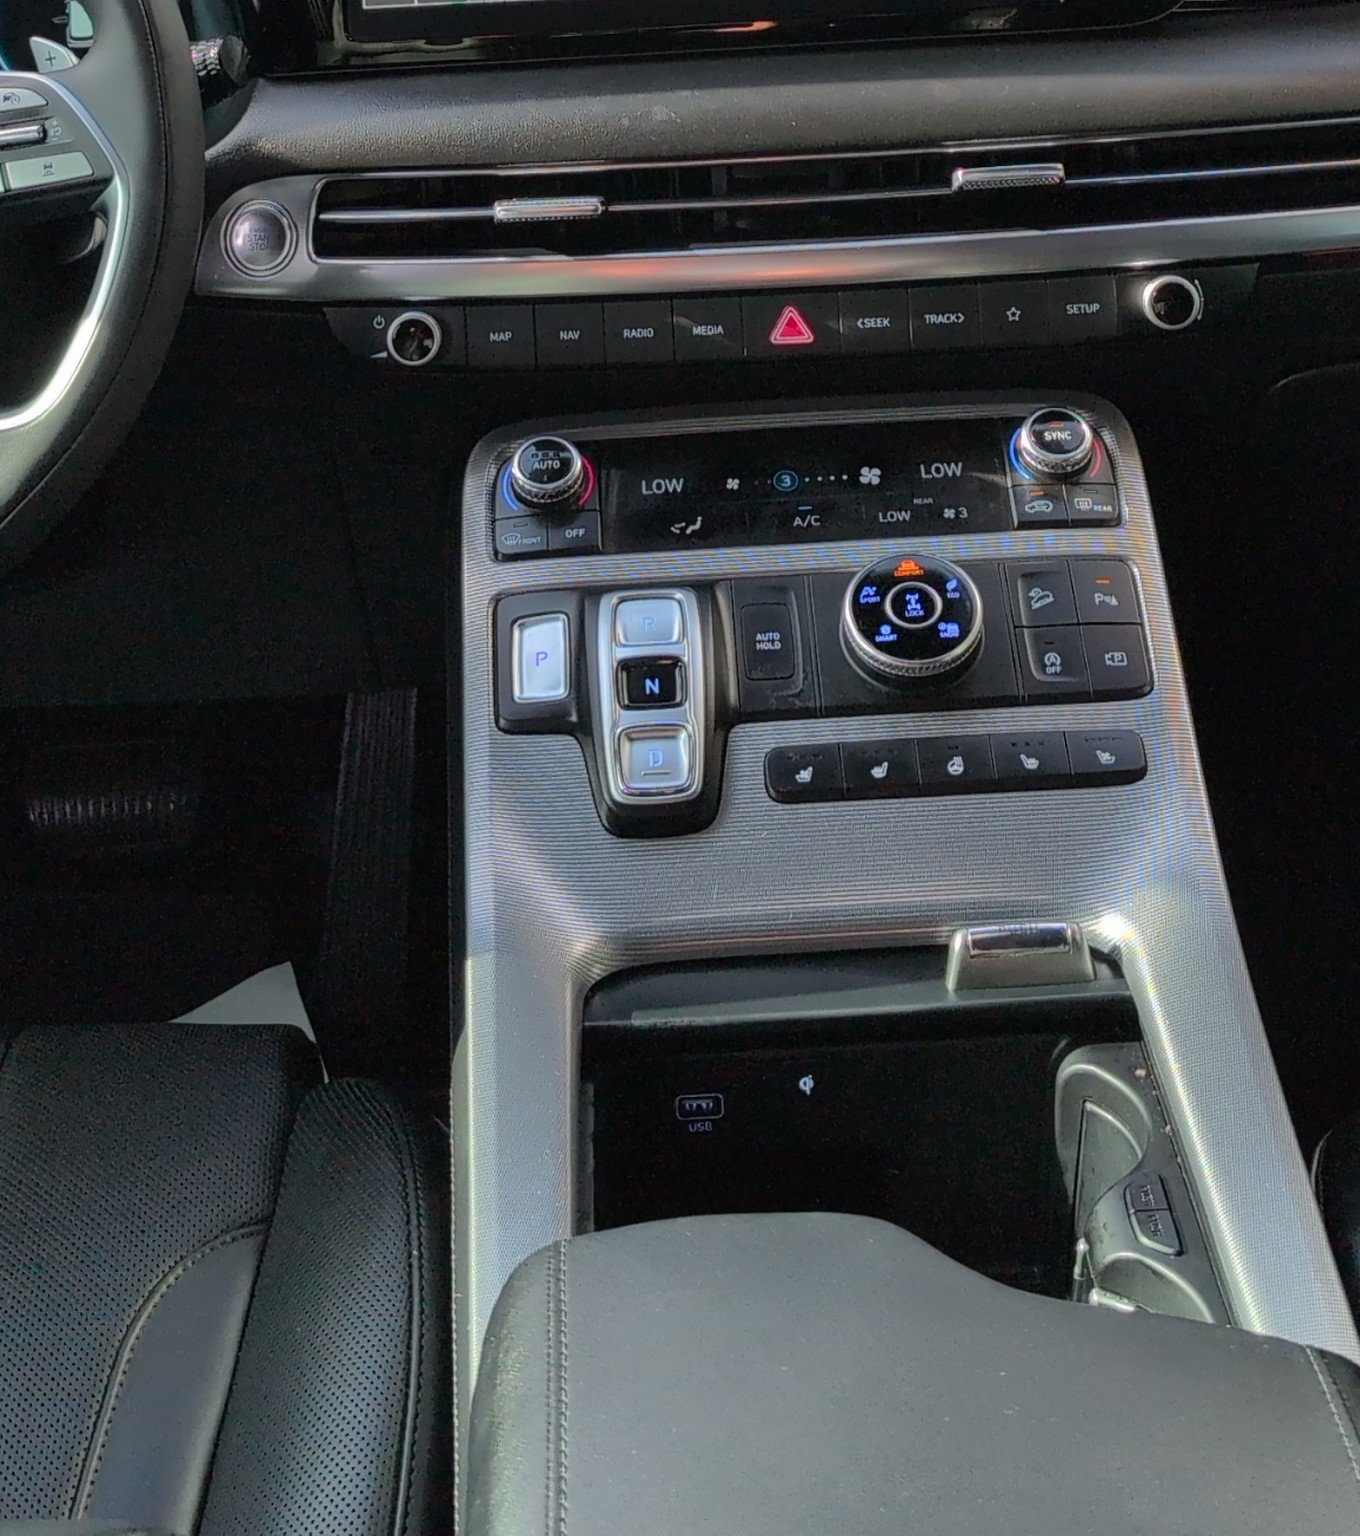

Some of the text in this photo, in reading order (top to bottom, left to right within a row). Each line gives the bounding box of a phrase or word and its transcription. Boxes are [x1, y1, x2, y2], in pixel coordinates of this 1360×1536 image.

[1066, 303, 1100, 316] SETUP
[560, 330, 580, 341] NAV
[623, 327, 654, 339] RADIO
[692, 324, 724, 336] MEDIA
[489, 331, 512, 343] MAP
[1043, 430, 1072, 442] SYNC
[532, 459, 561, 470] AUTO
[919, 461, 963, 479] LOW
[641, 478, 684, 495] LOW
[878, 510, 911, 523] LOW
[957, 506, 968, 519] 3
[792, 514, 821, 528] A/C
[564, 528, 586, 539] OFF
[755, 631, 780, 642] AUTO
[755, 641, 781, 651] HOLD
[534, 650, 548, 667] P
[1045, 665, 1062, 675] OFF
[644, 677, 660, 695] N
[648, 749, 664, 767] D
